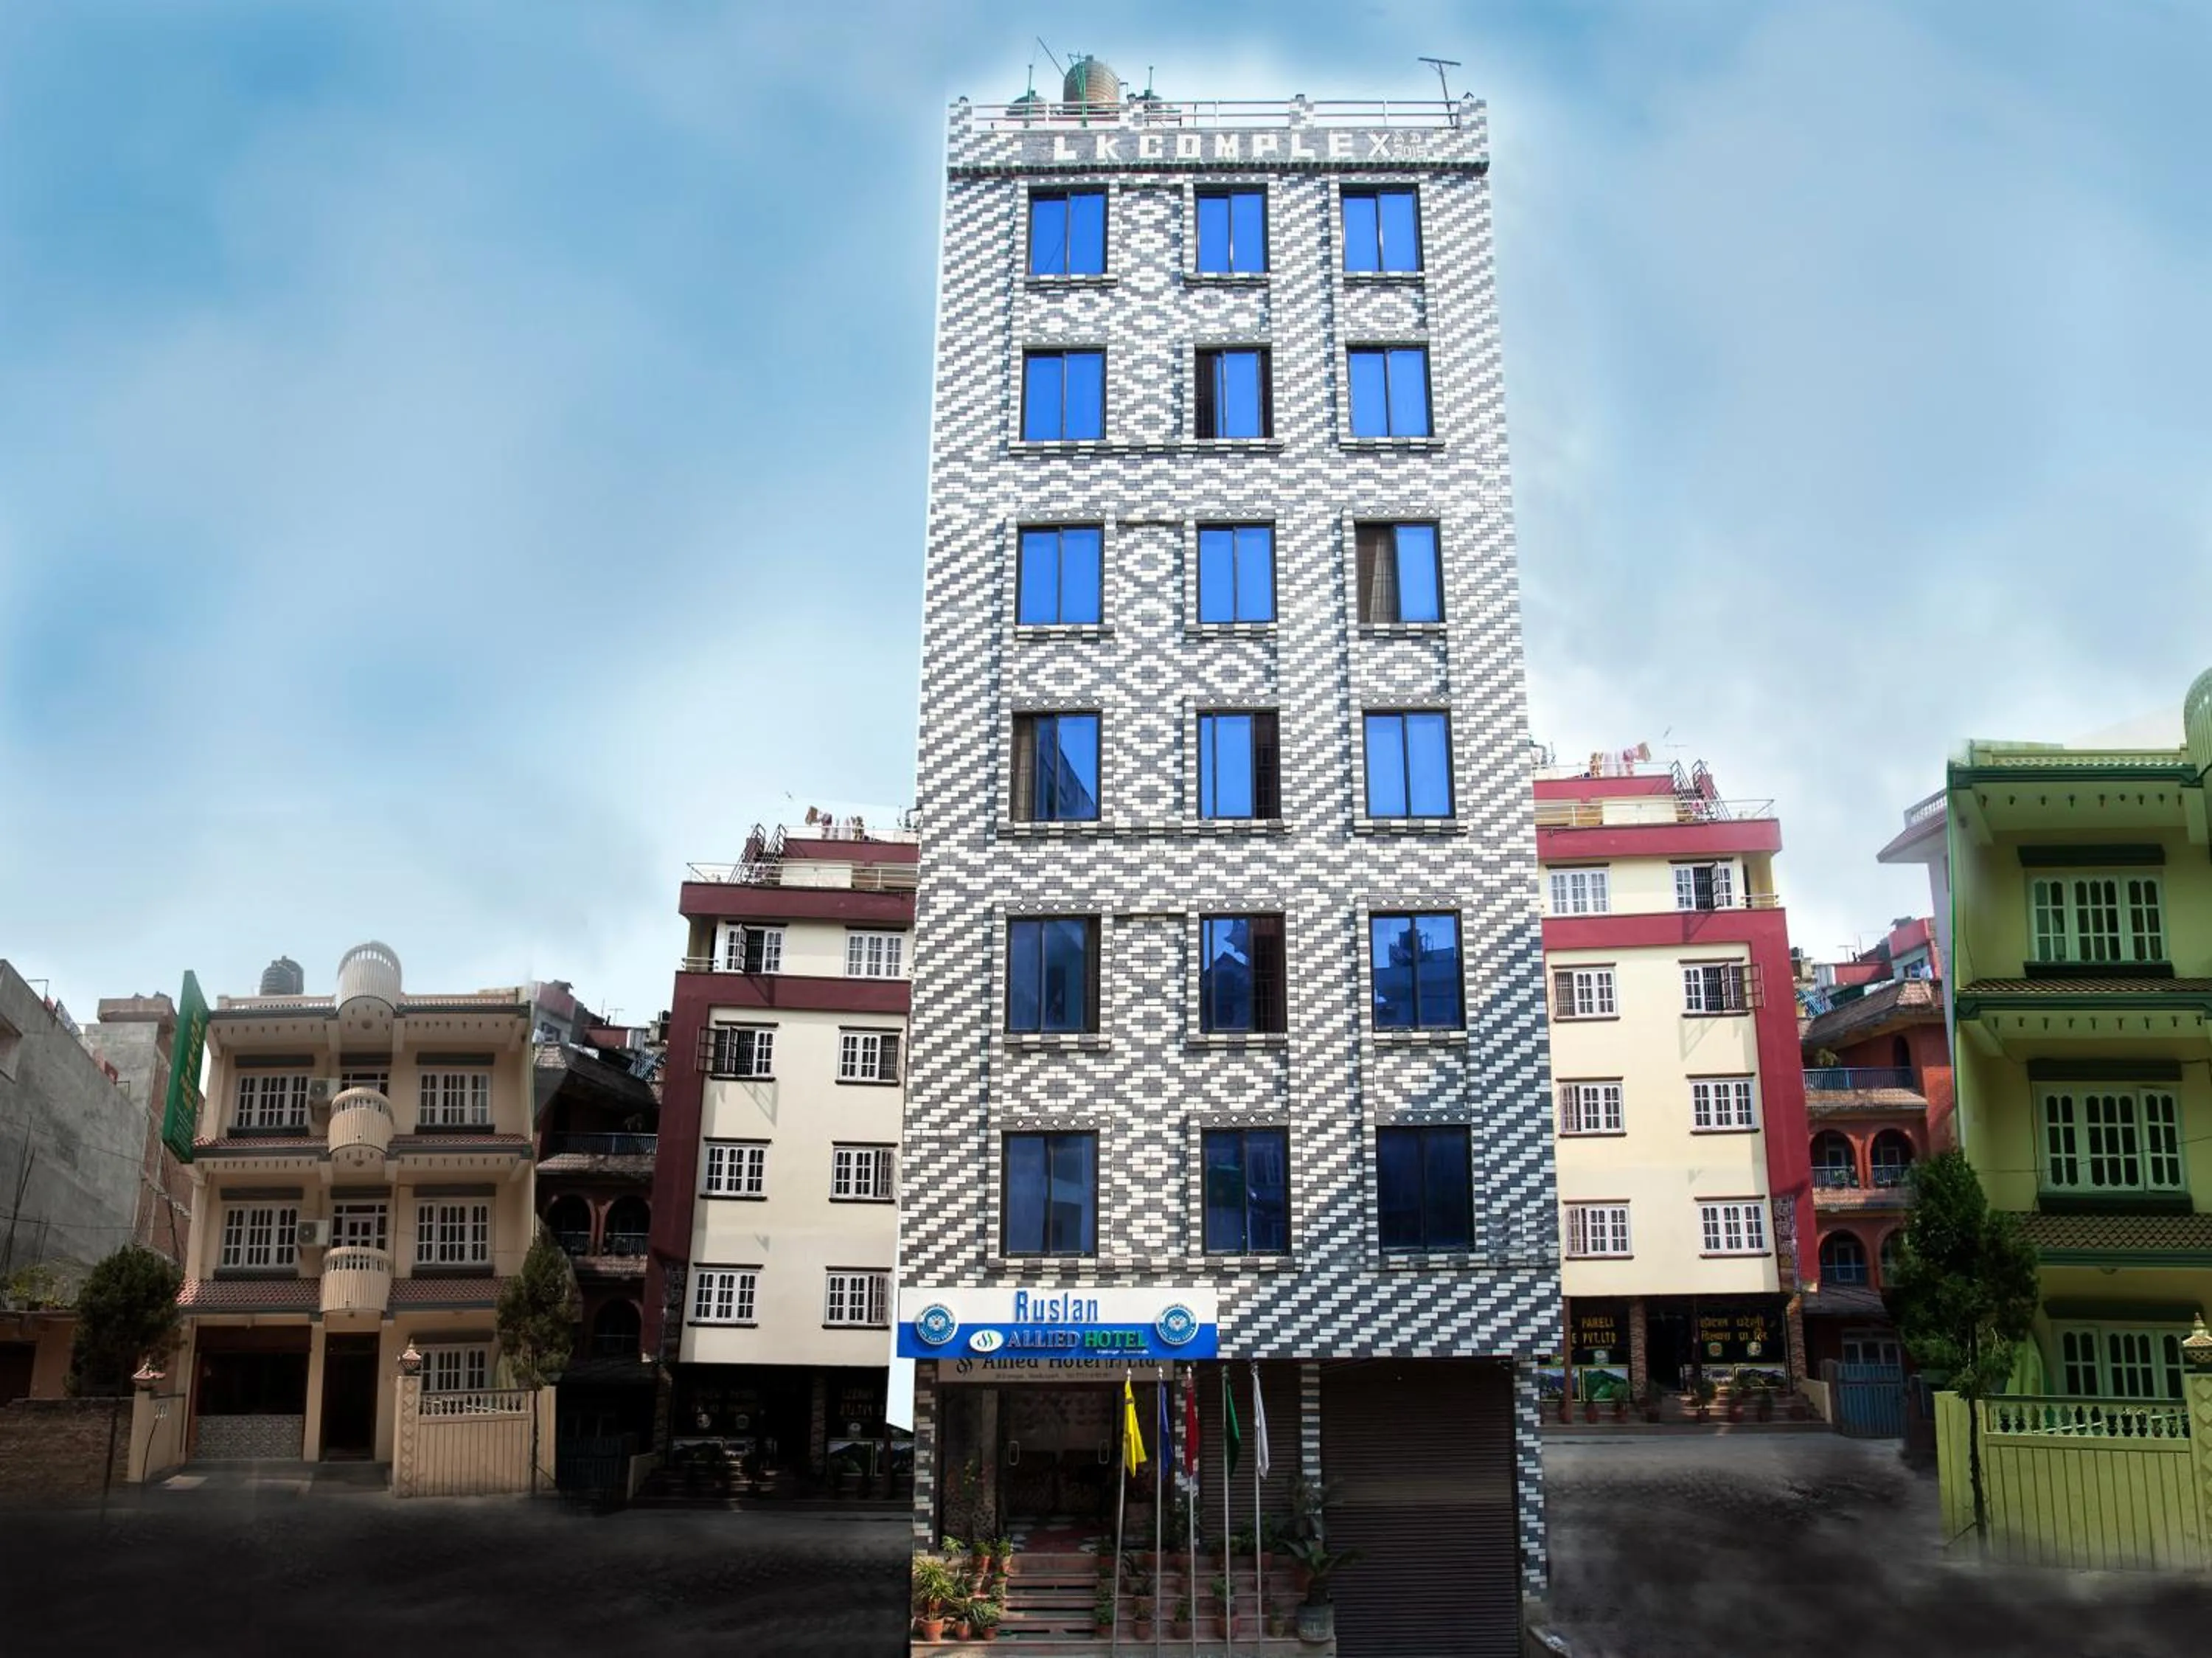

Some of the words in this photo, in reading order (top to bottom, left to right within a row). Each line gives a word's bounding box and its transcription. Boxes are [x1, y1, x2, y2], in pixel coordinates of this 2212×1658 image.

[1015, 1290, 1099, 1322] Ruslan
[1007, 1330, 1080, 1348] ALLIED
[1085, 1330, 1148, 1348] HOTEL
